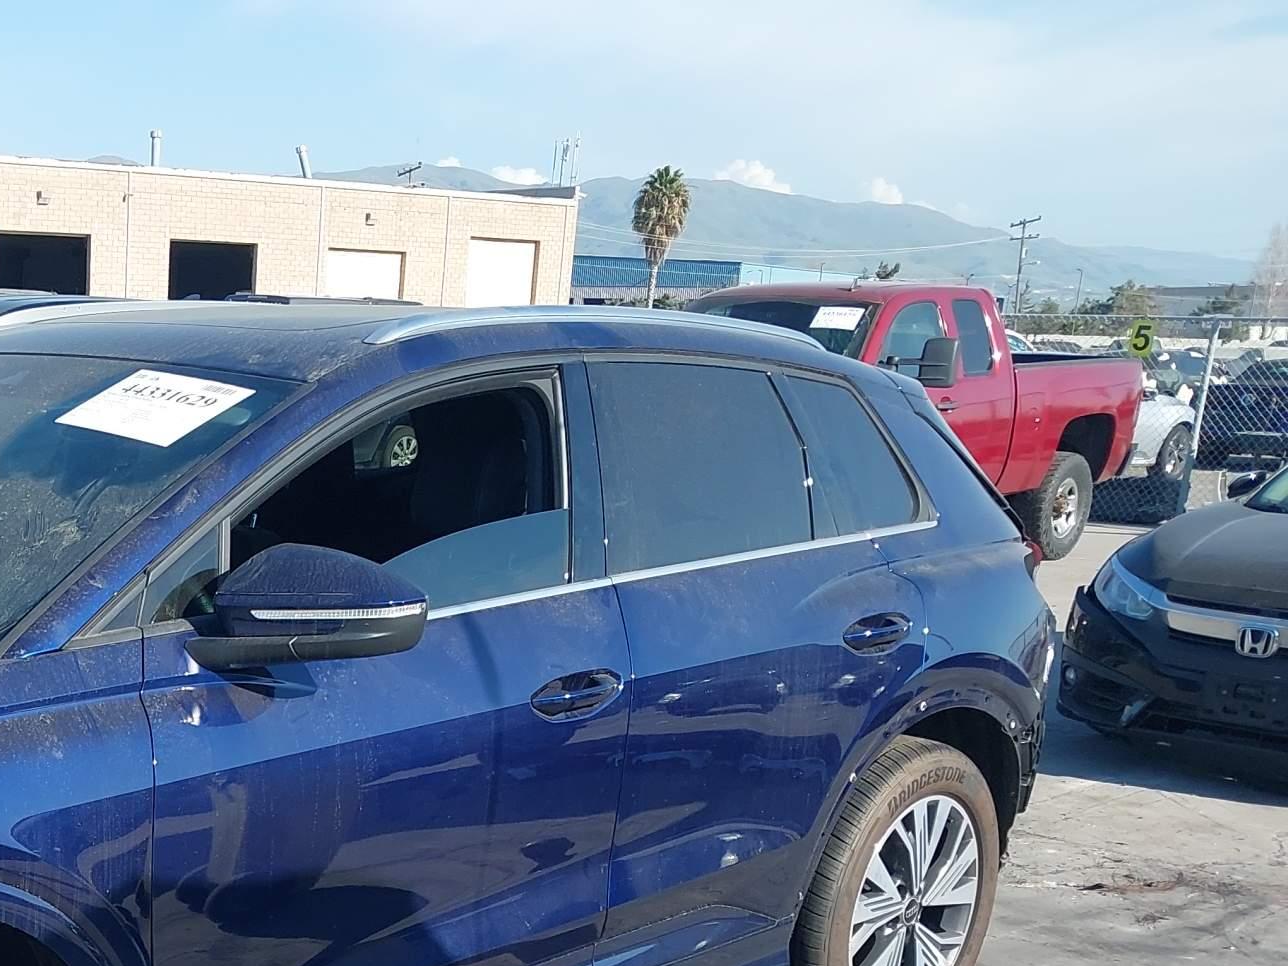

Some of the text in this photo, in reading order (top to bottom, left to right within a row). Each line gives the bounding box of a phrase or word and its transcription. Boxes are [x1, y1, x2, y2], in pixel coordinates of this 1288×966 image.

[1132, 325, 1152, 351] 5
[122, 383, 218, 408] 44331629
[887, 766, 967, 819] BRIDGESTONE
